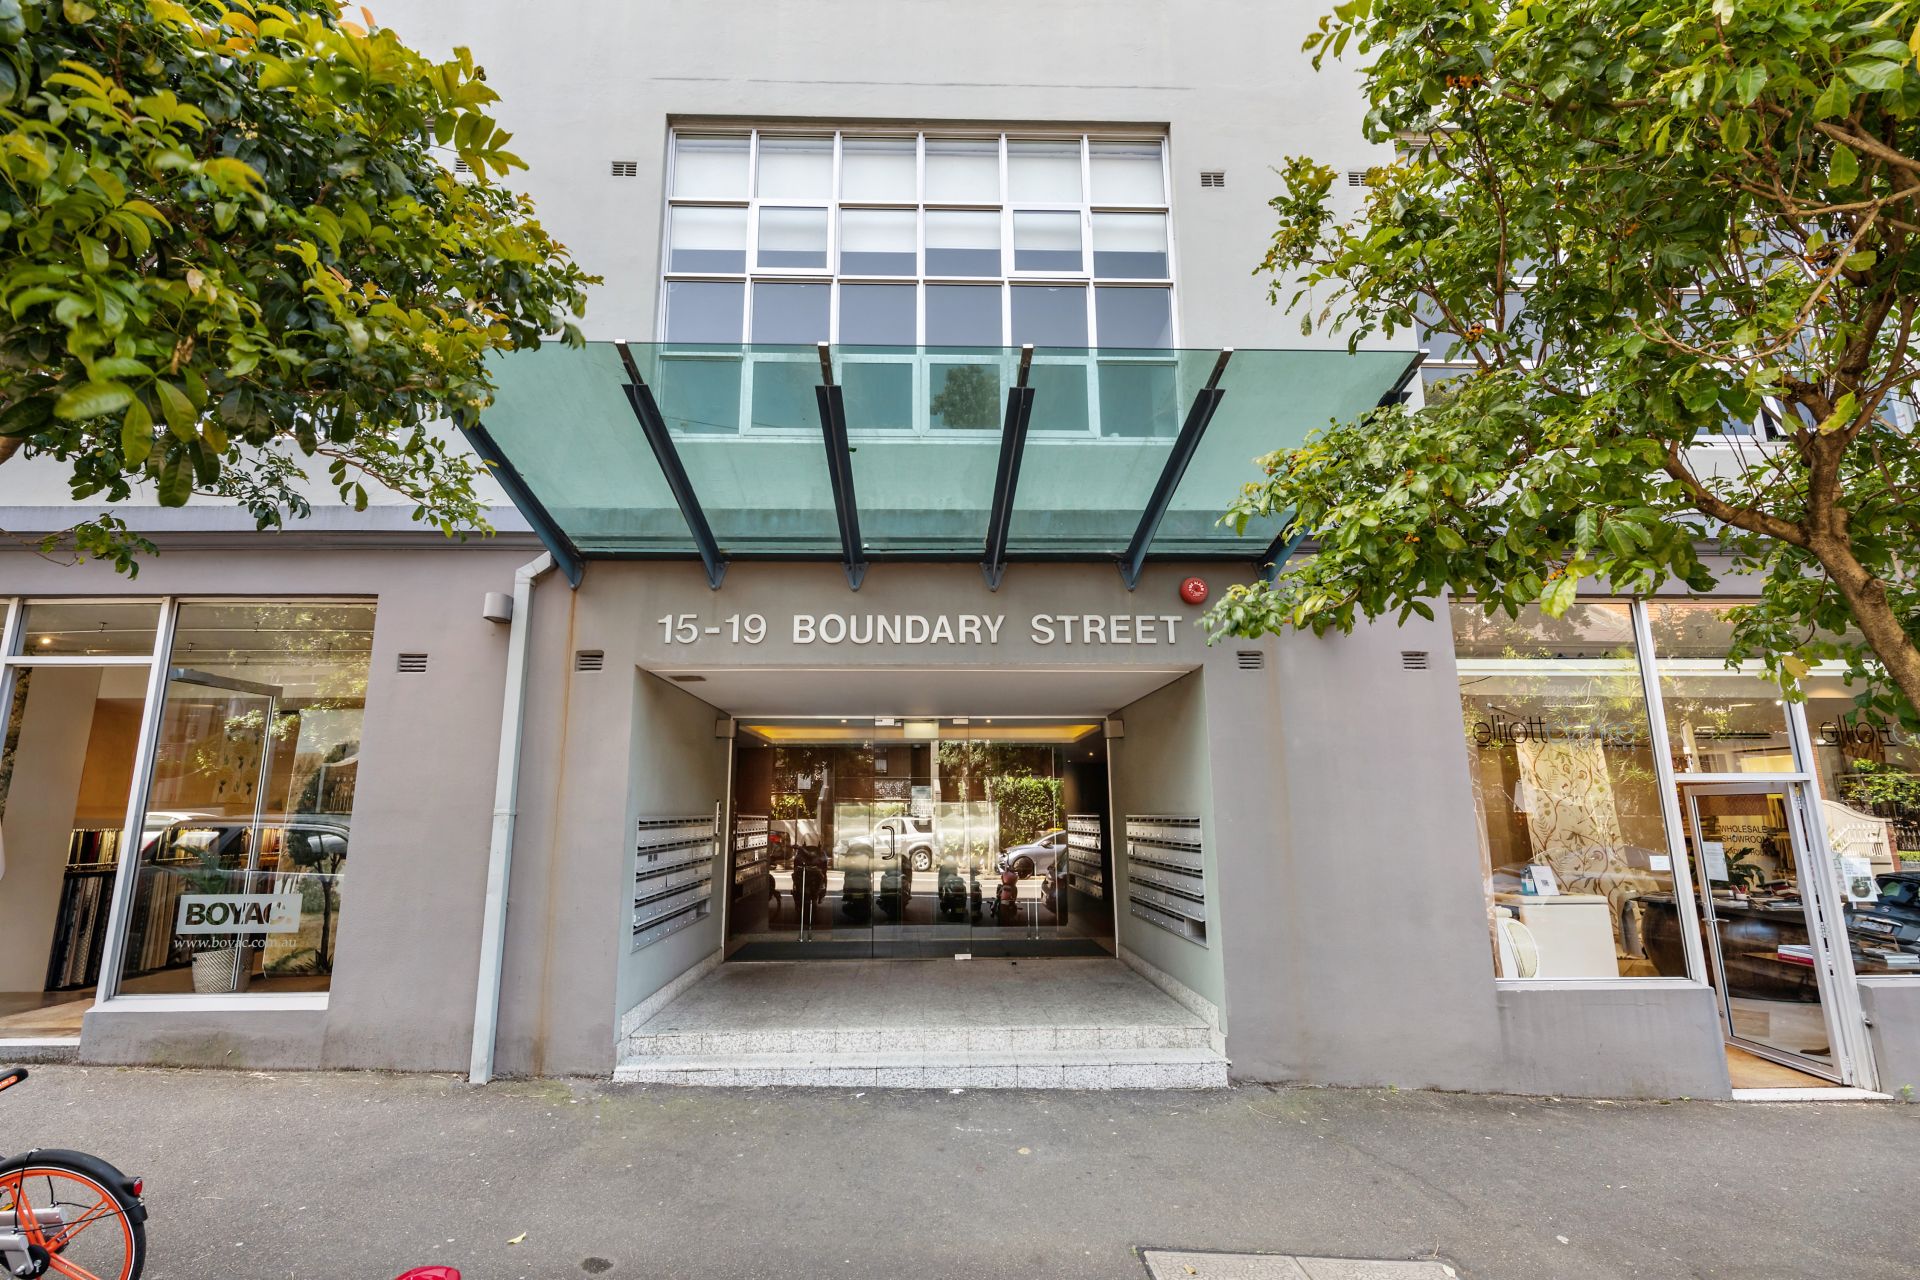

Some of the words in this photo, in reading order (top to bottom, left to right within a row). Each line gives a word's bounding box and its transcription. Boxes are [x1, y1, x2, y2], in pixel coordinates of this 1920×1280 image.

[657, 613, 768, 645] 15-19
[793, 613, 1006, 645] BOUNDARY
[1031, 613, 1183, 645] STREET
[1720, 825, 1768, 834] WHOLESALE
